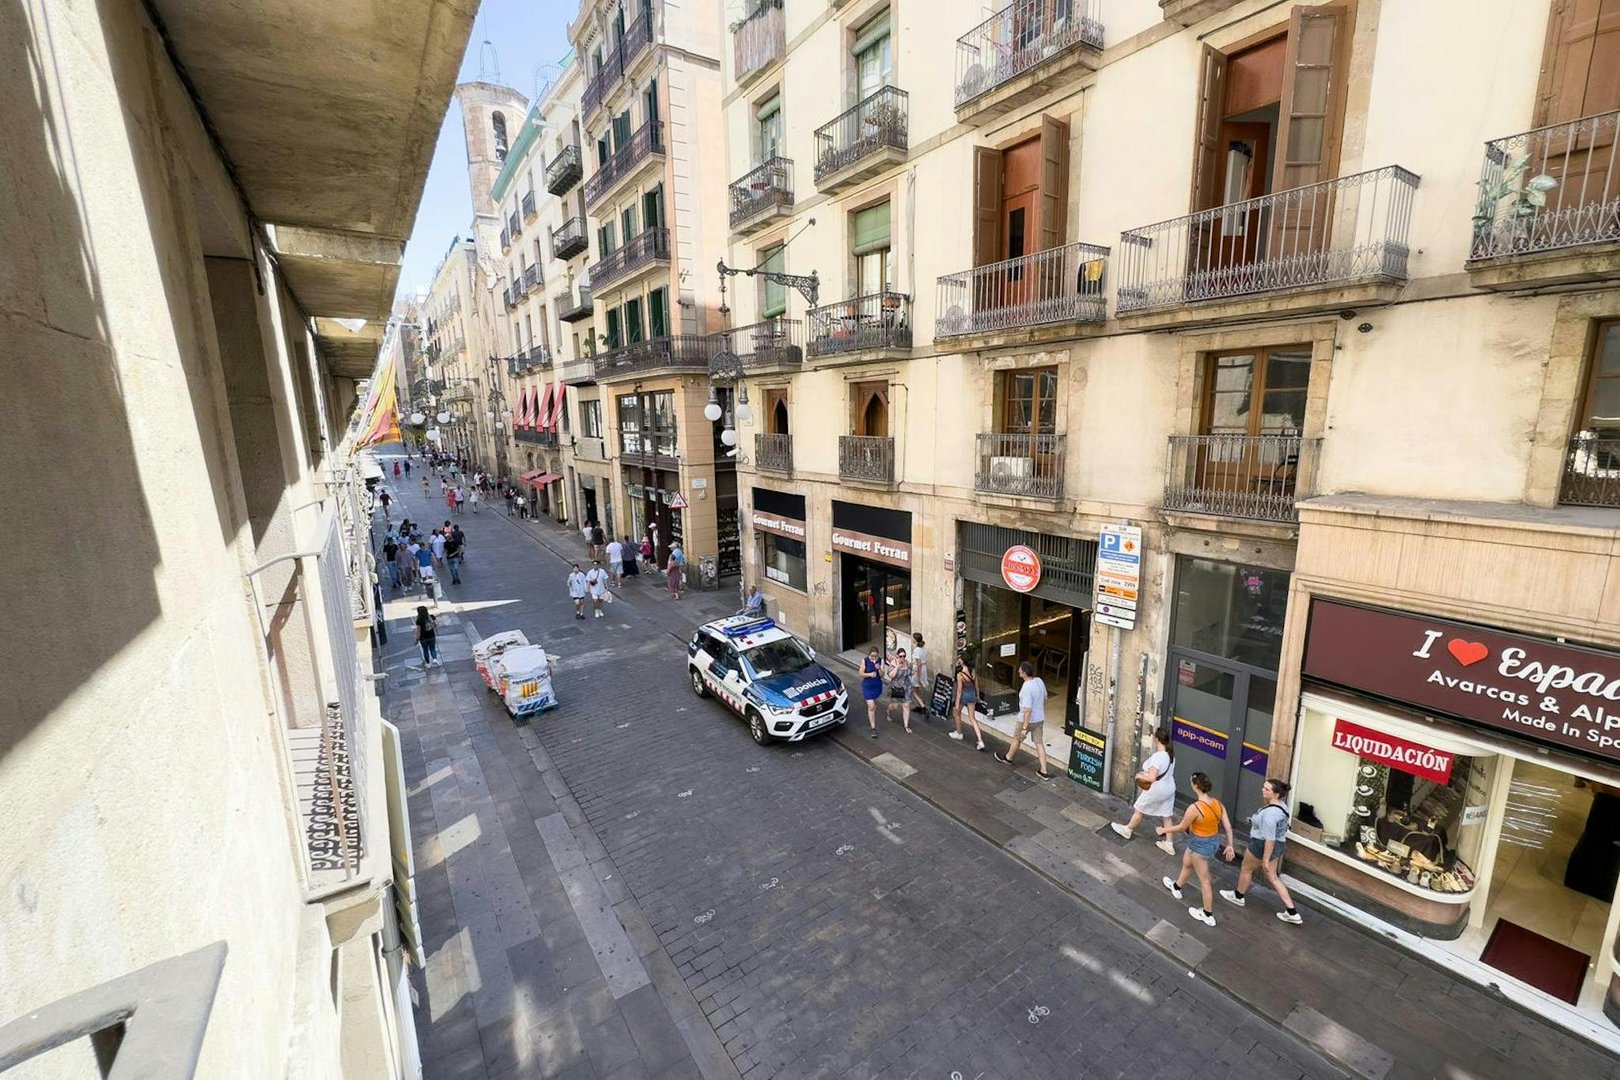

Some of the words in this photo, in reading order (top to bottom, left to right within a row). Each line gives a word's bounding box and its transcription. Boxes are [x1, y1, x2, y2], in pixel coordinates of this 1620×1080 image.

[752, 514, 780, 529] Gourmet
[781, 520, 805, 536] Ferran
[832, 532, 872, 551] Gourmet
[874, 541, 909, 561] Ferran
[1104, 534, 1116, 549] P
[1412, 629, 1443, 659] I
[1427, 669, 1530, 706] Avarcas
[1539, 696, 1560, 714] &
[1570, 704, 1620, 731] Alp
[1501, 707, 1556, 732] Made
[1562, 722, 1580, 738] In
[1177, 727, 1225, 751] apip-acam
[1334, 731, 1450, 773] LIQUIDACIÓN
[1080, 761, 1096, 774] FOOD
